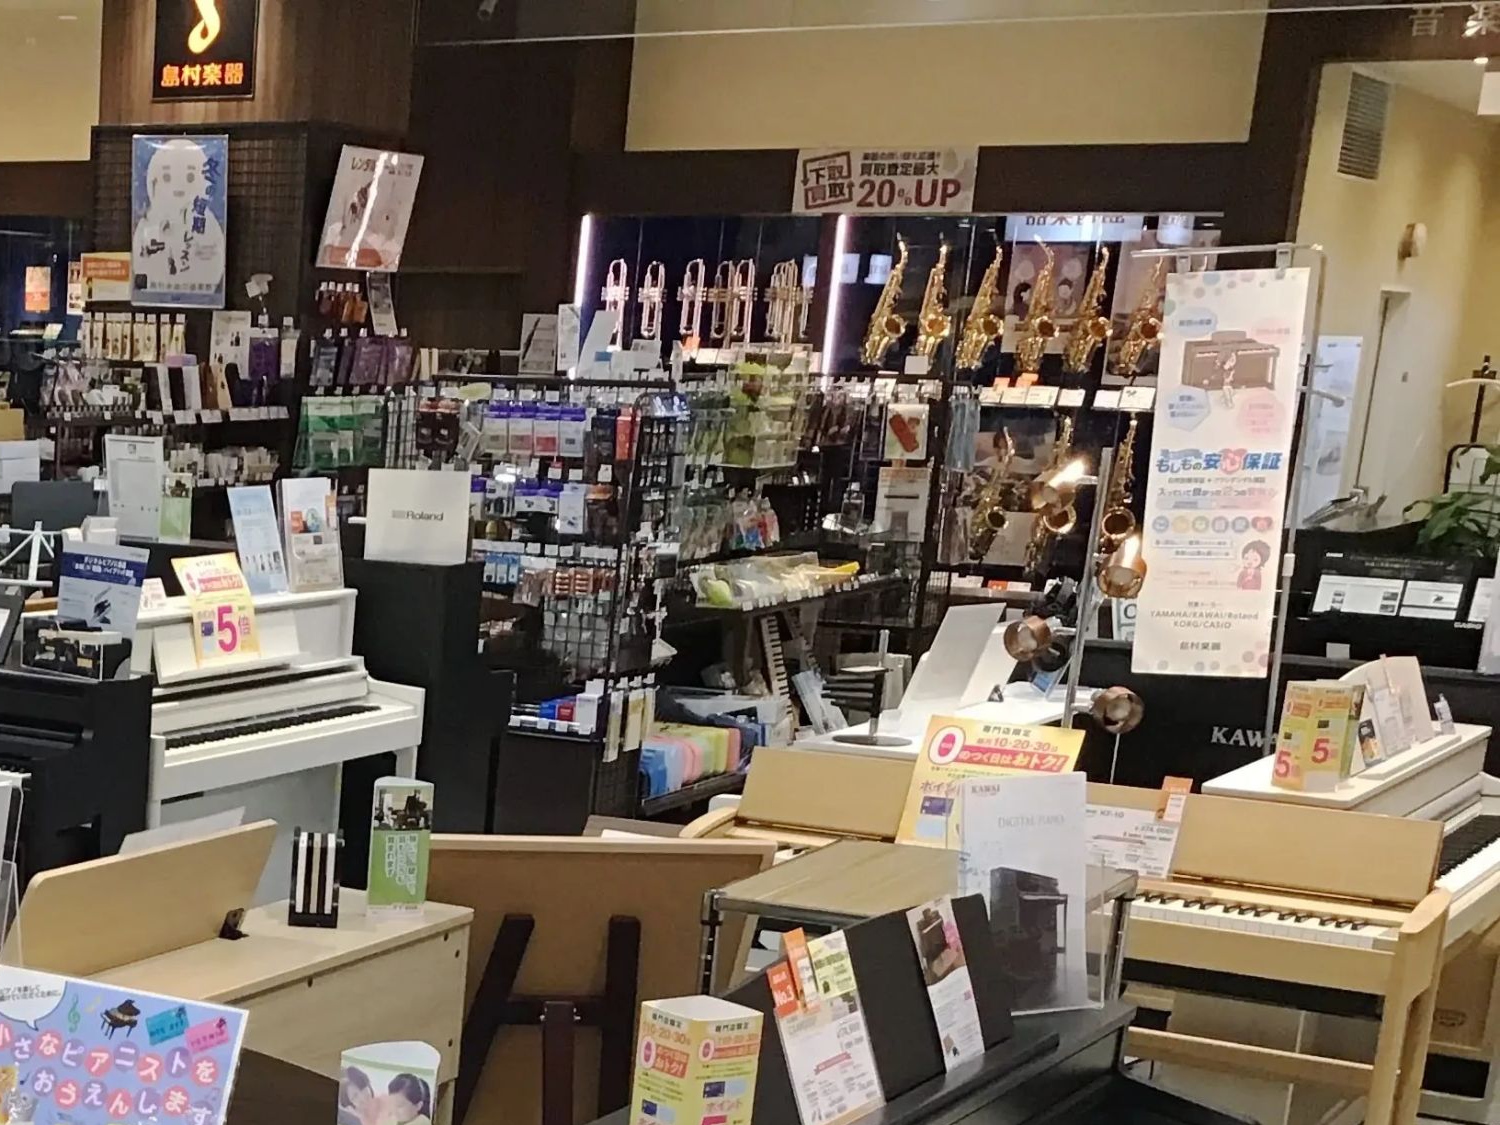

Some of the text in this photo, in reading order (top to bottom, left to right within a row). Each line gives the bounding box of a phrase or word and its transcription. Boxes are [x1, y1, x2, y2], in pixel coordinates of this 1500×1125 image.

[161, 63, 244, 87] 島村楽器
[810, 164, 845, 184] 下取
[860, 162, 940, 177] 買取査定最大
[856, 178, 961, 208] 20%UP
[406, 510, 444, 521] Roland
[983, 725, 1032, 737] 専門店限定
[971, 784, 1000, 793] KAWAI
